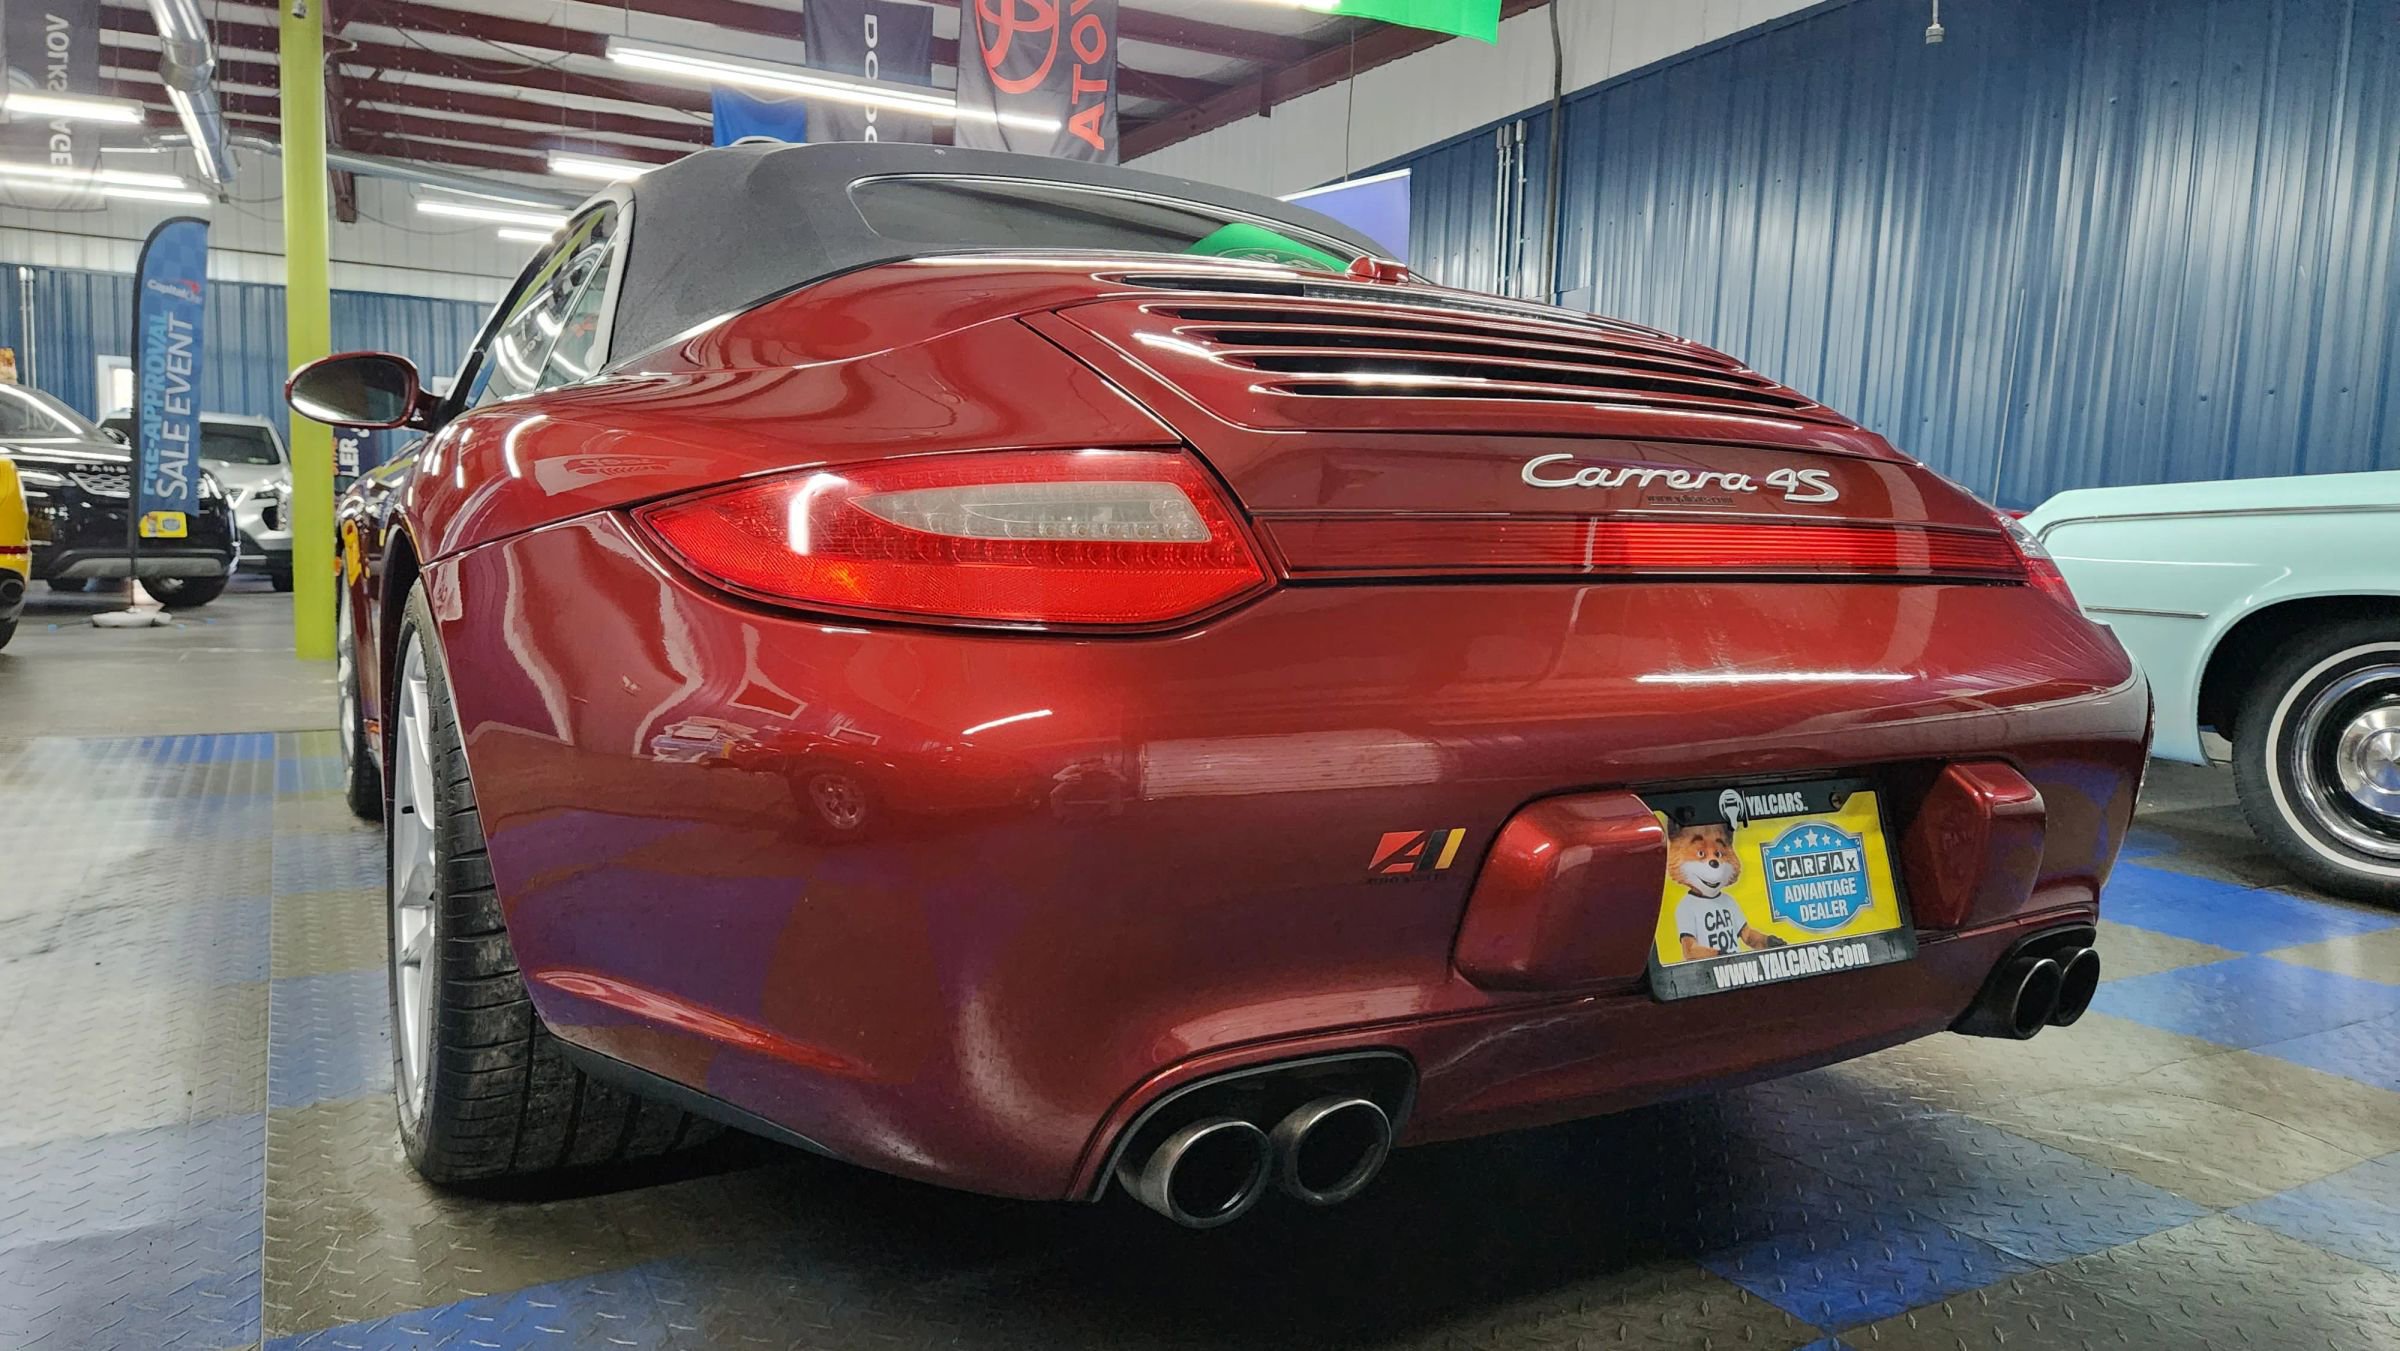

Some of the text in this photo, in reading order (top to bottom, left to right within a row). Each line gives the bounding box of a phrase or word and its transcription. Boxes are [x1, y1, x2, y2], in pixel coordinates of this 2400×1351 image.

[156, 311, 193, 500] SALE EVENT
[1521, 453, 1839, 502] Carrera 4S
[1773, 850, 1860, 880] CARFAX
[1784, 877, 1857, 904] ADVANTAGE
[1704, 909, 1733, 932] CAR
[1800, 900, 1849, 923] DEALER
[1709, 930, 1738, 949] FOX
[1712, 942, 1870, 989] www.YALCARS.com
